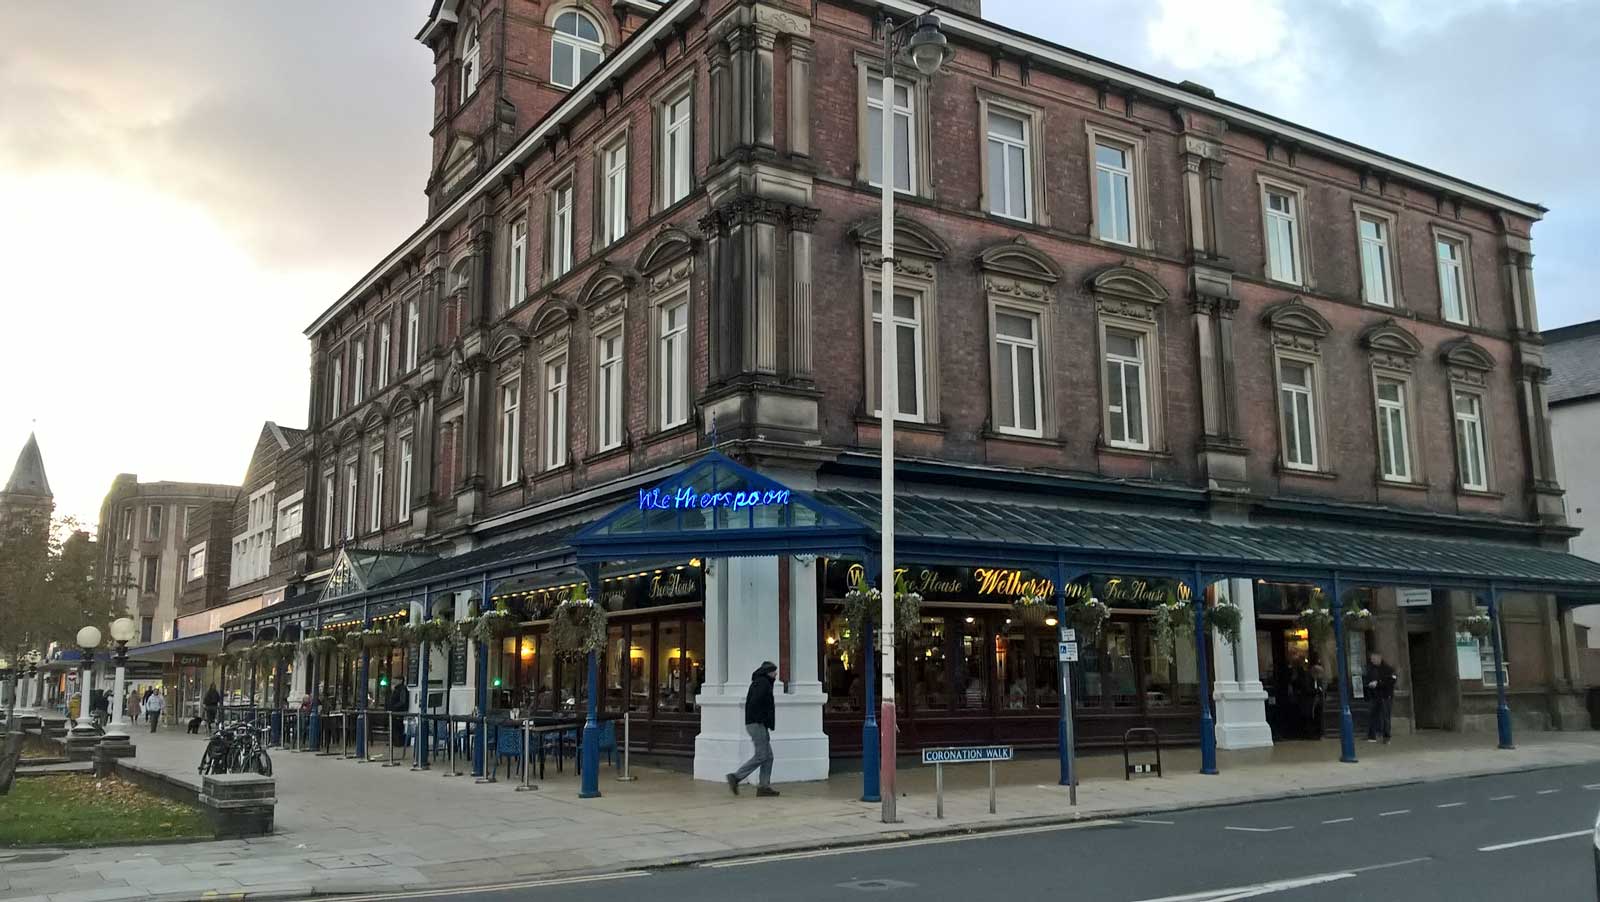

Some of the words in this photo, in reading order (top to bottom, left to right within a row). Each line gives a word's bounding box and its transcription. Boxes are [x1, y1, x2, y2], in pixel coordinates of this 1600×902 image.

[639, 487, 790, 511] Wetherspoon
[668, 573, 696, 597] House
[919, 569, 962, 593] House
[974, 568, 1087, 599] Wetherspons
[1130, 579, 1165, 601] House
[926, 749, 982, 760] CORONATION
[986, 748, 1008, 759] WALK
